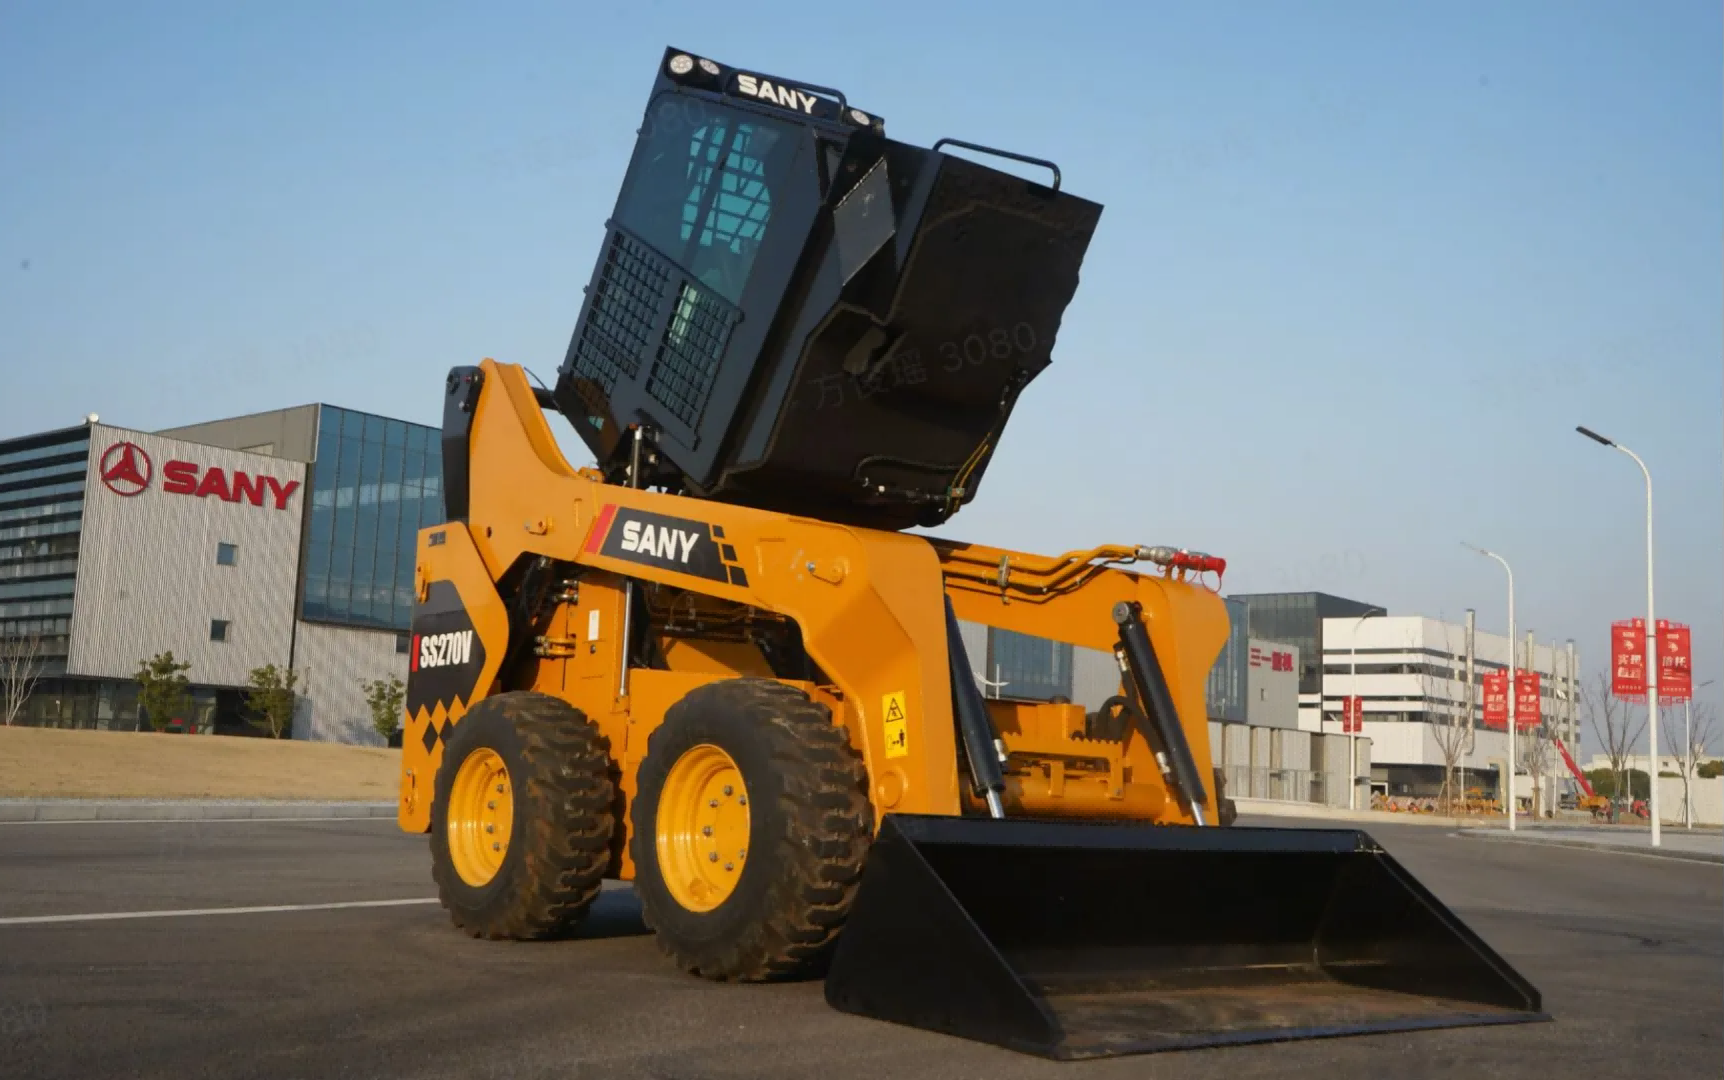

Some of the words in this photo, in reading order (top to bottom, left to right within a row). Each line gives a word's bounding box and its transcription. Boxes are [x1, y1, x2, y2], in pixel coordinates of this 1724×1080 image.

[737, 74, 817, 114] SANY
[163, 459, 300, 510] SANY
[621, 520, 699, 564] SANY
[419, 630, 473, 669] SS270V
